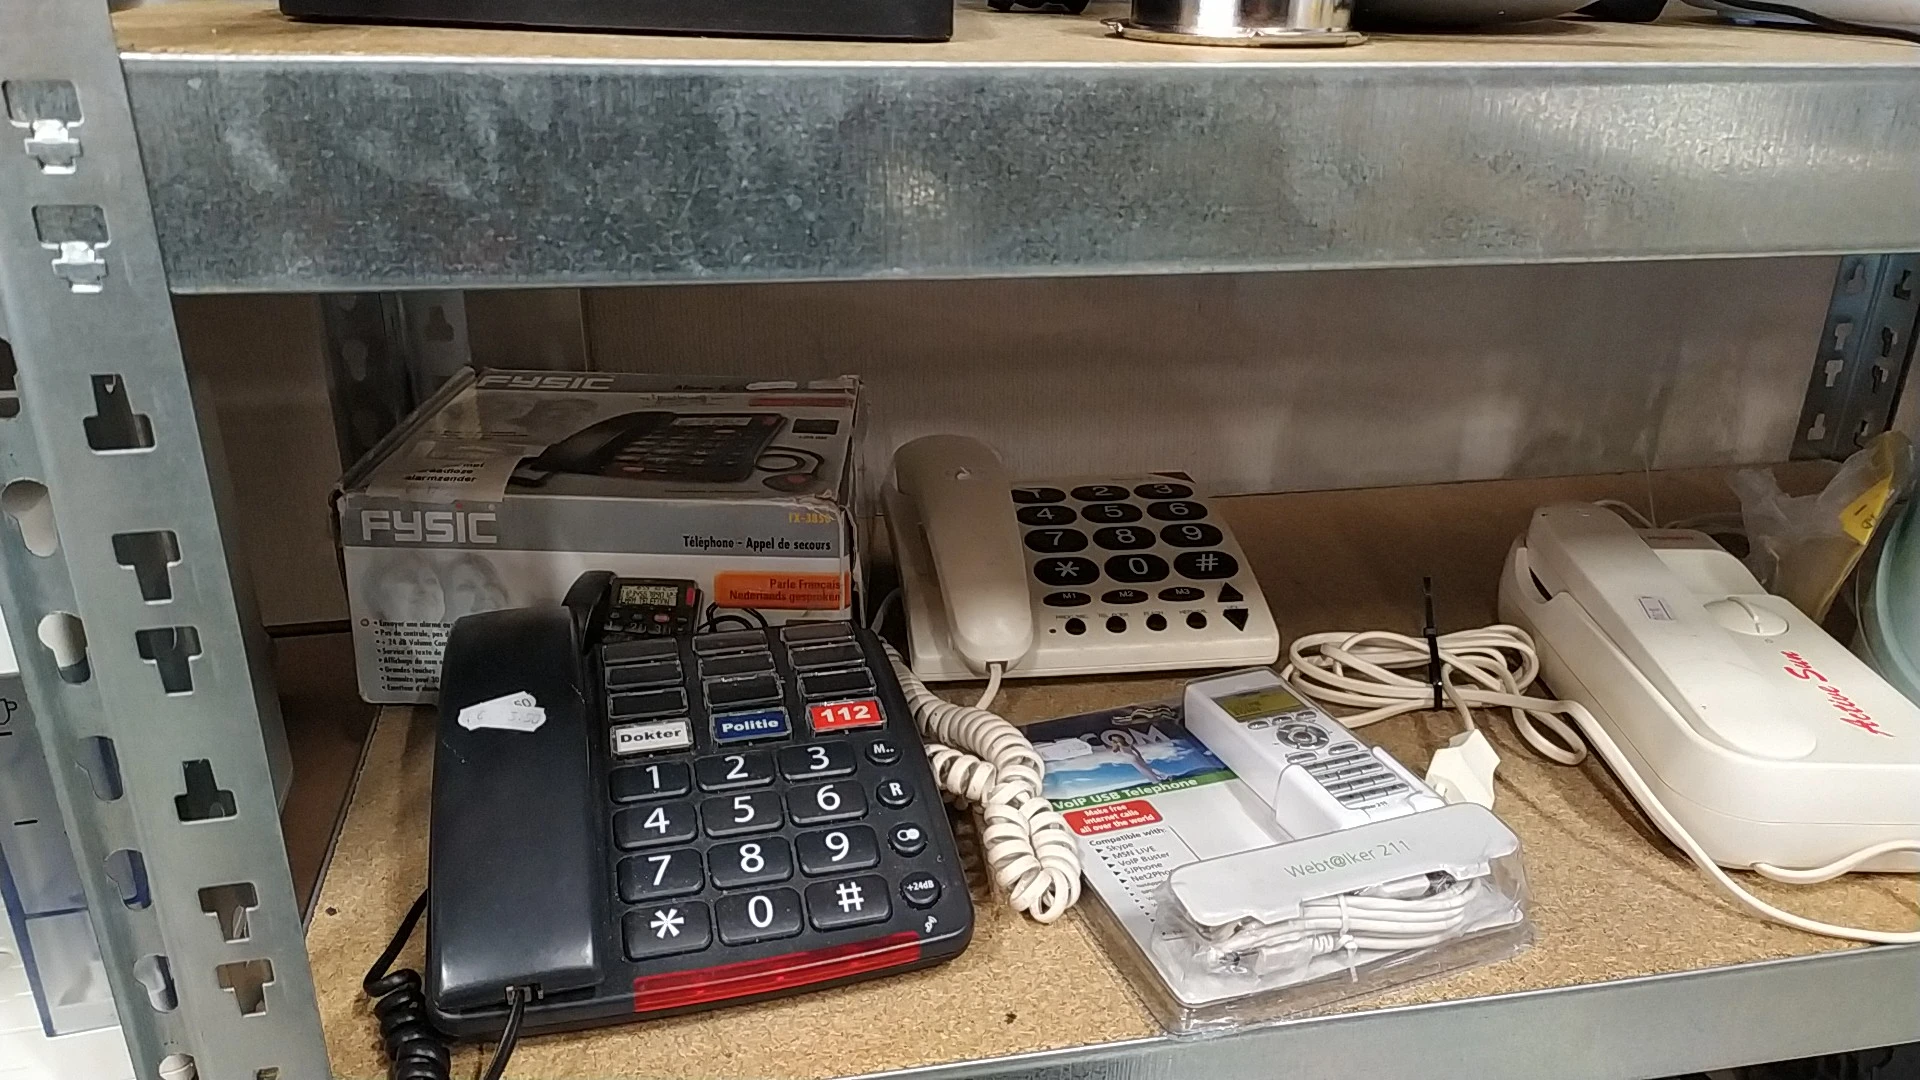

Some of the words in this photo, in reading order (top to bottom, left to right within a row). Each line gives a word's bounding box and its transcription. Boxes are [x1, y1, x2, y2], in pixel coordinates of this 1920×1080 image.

[476, 375, 615, 391] FYSIC
[1092, 486, 1113, 496] 2
[1155, 484, 1173, 494] 3
[1036, 507, 1054, 520] 4
[1104, 505, 1123, 518] 5
[1169, 503, 1189, 515] 6
[361, 509, 497, 544] FYSIC
[683, 535, 734, 549] Téléphone
[746, 537, 774, 552] Appel
[778, 538, 790, 550] de
[793, 541, 831, 550] secours
[1045, 531, 1064, 546] 7
[1116, 529, 1136, 544] 8
[1181, 525, 1202, 541] 9
[1128, 557, 1149, 575] 0
[769, 578, 797, 590] Parle
[799, 579, 841, 592] Français
[729, 590, 786, 601] Nederlands
[789, 591, 840, 603] gesproken
[821, 705, 871, 723] 112
[722, 718, 779, 733] Politie
[620, 729, 681, 743] Dokter
[645, 765, 660, 789] 1
[724, 756, 748, 780] 2
[807, 747, 829, 770] 3
[889, 782, 903, 796] R
[1053, 797, 1090, 810] VoIP
[1090, 791, 1120, 804] USB
[1123, 779, 1198, 798] Telephone
[643, 807, 670, 834] 4
[734, 795, 755, 823] 5
[817, 784, 841, 811] 6
[1083, 813, 1119, 825] internet
[1120, 809, 1139, 818] calls
[1084, 808, 1108, 817] Make
[1109, 804, 1127, 813] free
[1080, 825, 1092, 834] all
[1093, 823, 1113, 831] over
[1114, 819, 1128, 828] the
[1129, 814, 1155, 824] world
[1089, 833, 1141, 846] Compatible
[1142, 827, 1166, 837] with:
[1106, 842, 1134, 852] Skype
[1112, 850, 1135, 859] MSN
[1135, 845, 1156, 855] LIVE
[648, 854, 672, 886] 7
[739, 843, 765, 873] 8
[825, 831, 850, 861] 9
[1118, 857, 1139, 867] VoIP
[1140, 852, 1170, 862] Buster
[1284, 849, 1376, 878] Webt@lker
[1376, 840, 1410, 856] 211
[1124, 862, 1163, 874] SJPhone
[906, 878, 935, 892] +24dB
[748, 895, 774, 928] 0
[836, 881, 865, 913] #
